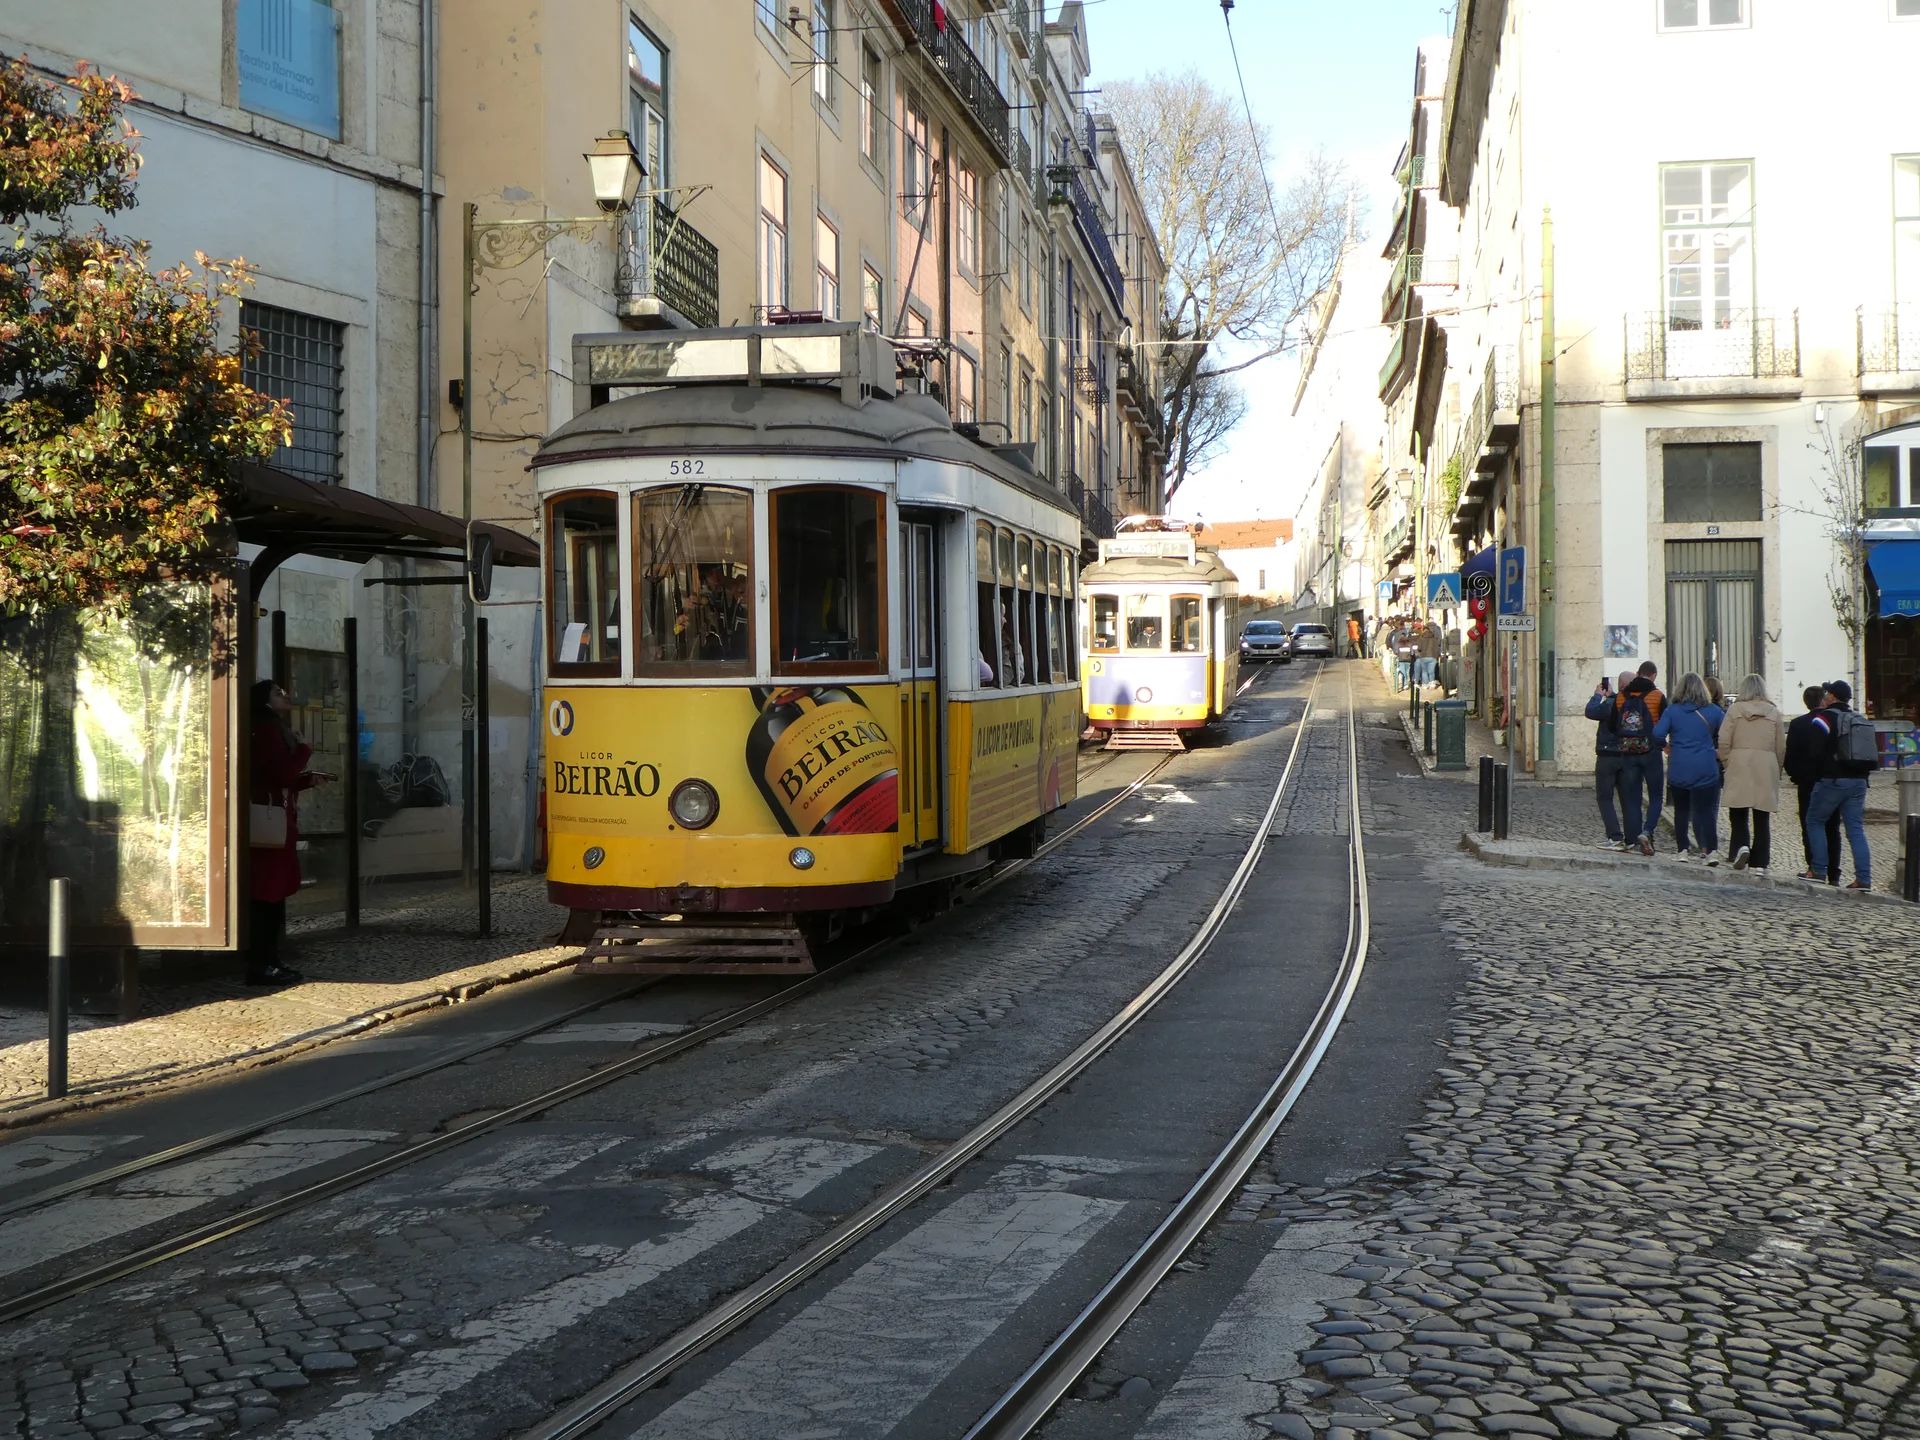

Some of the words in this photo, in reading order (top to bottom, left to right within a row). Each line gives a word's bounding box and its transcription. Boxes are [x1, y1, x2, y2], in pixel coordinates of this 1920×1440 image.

[238, 48, 271, 71] Teatro
[272, 61, 314, 86] Romano
[269, 77, 283, 91] de
[285, 81, 319, 104] Lisboa
[670, 460, 704, 475] 582
[1505, 559, 1518, 603] P
[1897, 599, 1912, 610] ERA
[1499, 618, 1531, 627] E.G.E.A.C.
[806, 719, 845, 744] LICOR
[580, 752, 613, 760] LICOR
[777, 719, 888, 805] BEIRÃO
[554, 760, 660, 797] BEIRÃO
[803, 801, 809, 810] O
[809, 776, 836, 803] LICOR
[837, 765, 851, 777] DE
[852, 748, 893, 768] PORTUGAL
